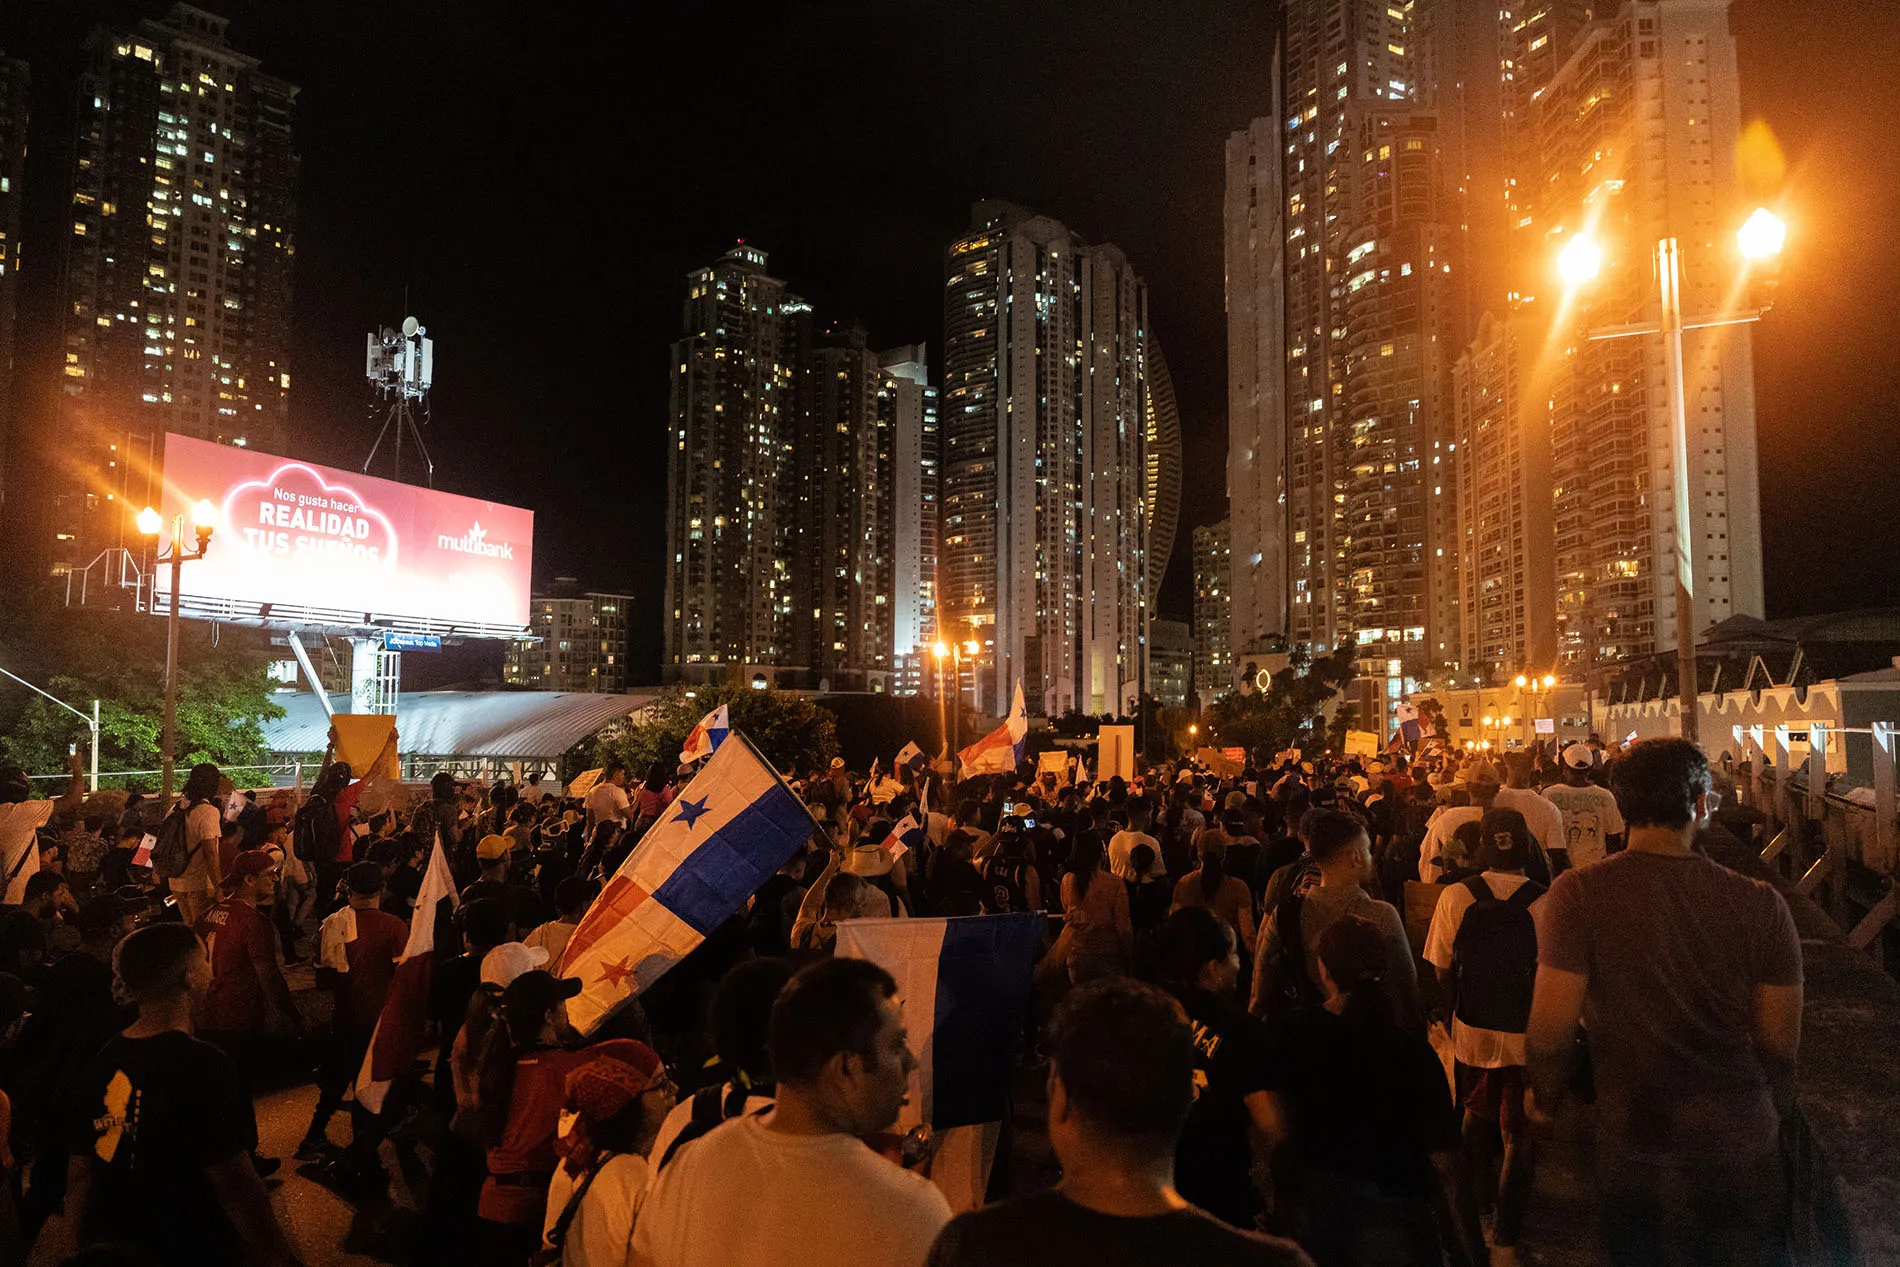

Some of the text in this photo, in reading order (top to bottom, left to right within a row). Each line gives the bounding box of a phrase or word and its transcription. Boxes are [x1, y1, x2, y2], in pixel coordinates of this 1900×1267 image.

[273, 487, 360, 514] Nos gusta hacer
[259, 501, 370, 540] REALIDAD
[243, 527, 290, 556] TUS
[438, 533, 513, 560] multibank
